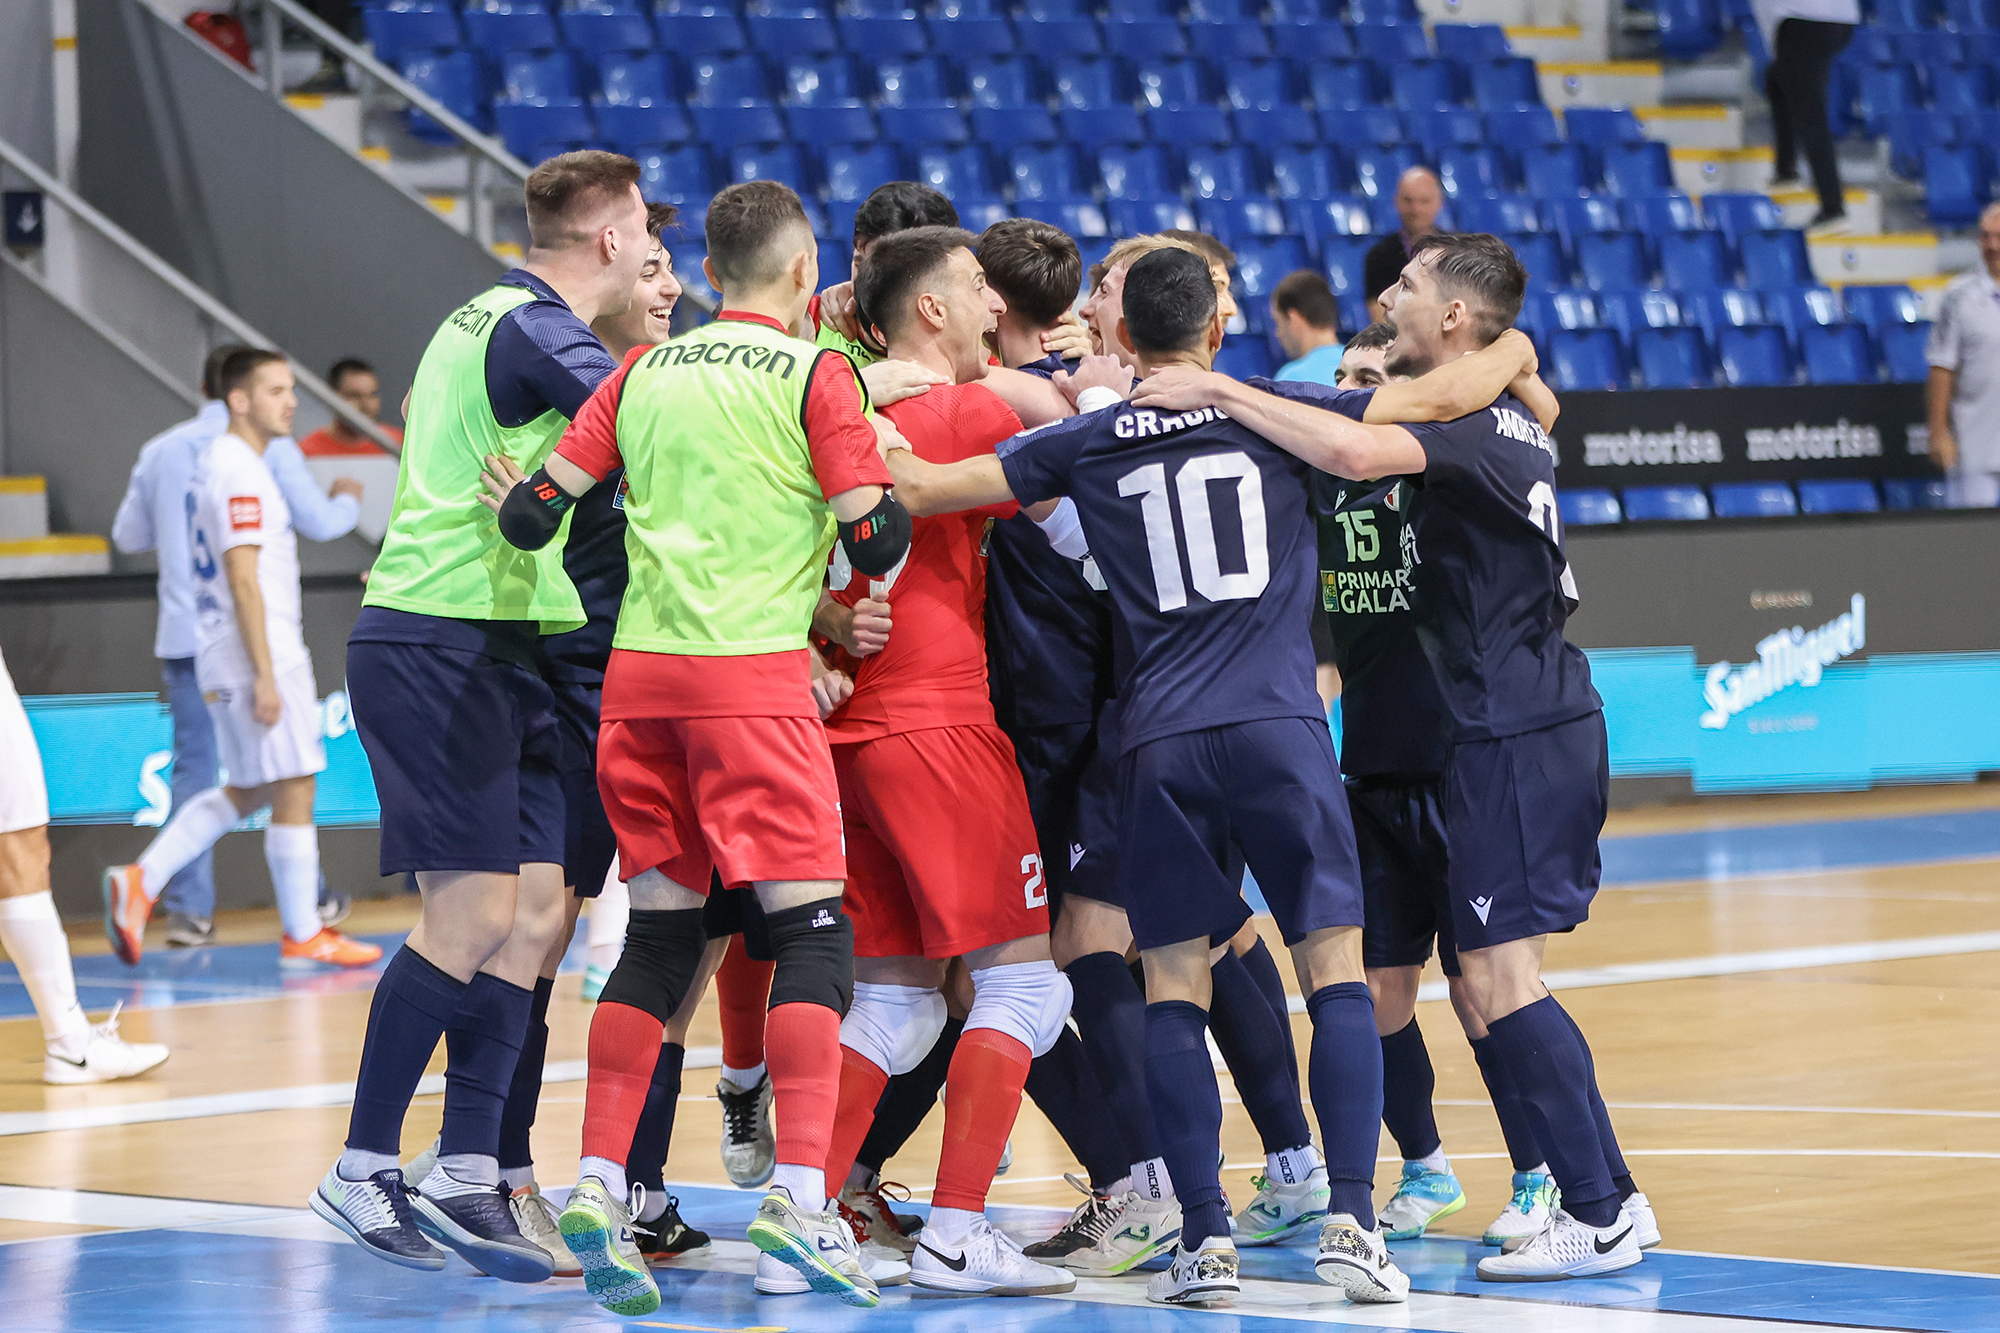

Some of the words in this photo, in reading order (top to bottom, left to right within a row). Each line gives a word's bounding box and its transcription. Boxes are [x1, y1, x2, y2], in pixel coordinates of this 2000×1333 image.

[646, 342, 796, 381] macron
[1583, 422, 1723, 467] motorisa
[1746, 416, 1883, 462] motorisa
[1117, 451, 1270, 613] 10
[1335, 509, 1380, 563] 15
[1338, 568, 1411, 590] PRIMAR
[1340, 586, 1416, 614] GALA
[1020, 851, 1049, 909] 2
[1145, 1162, 1162, 1199] SOCKS
